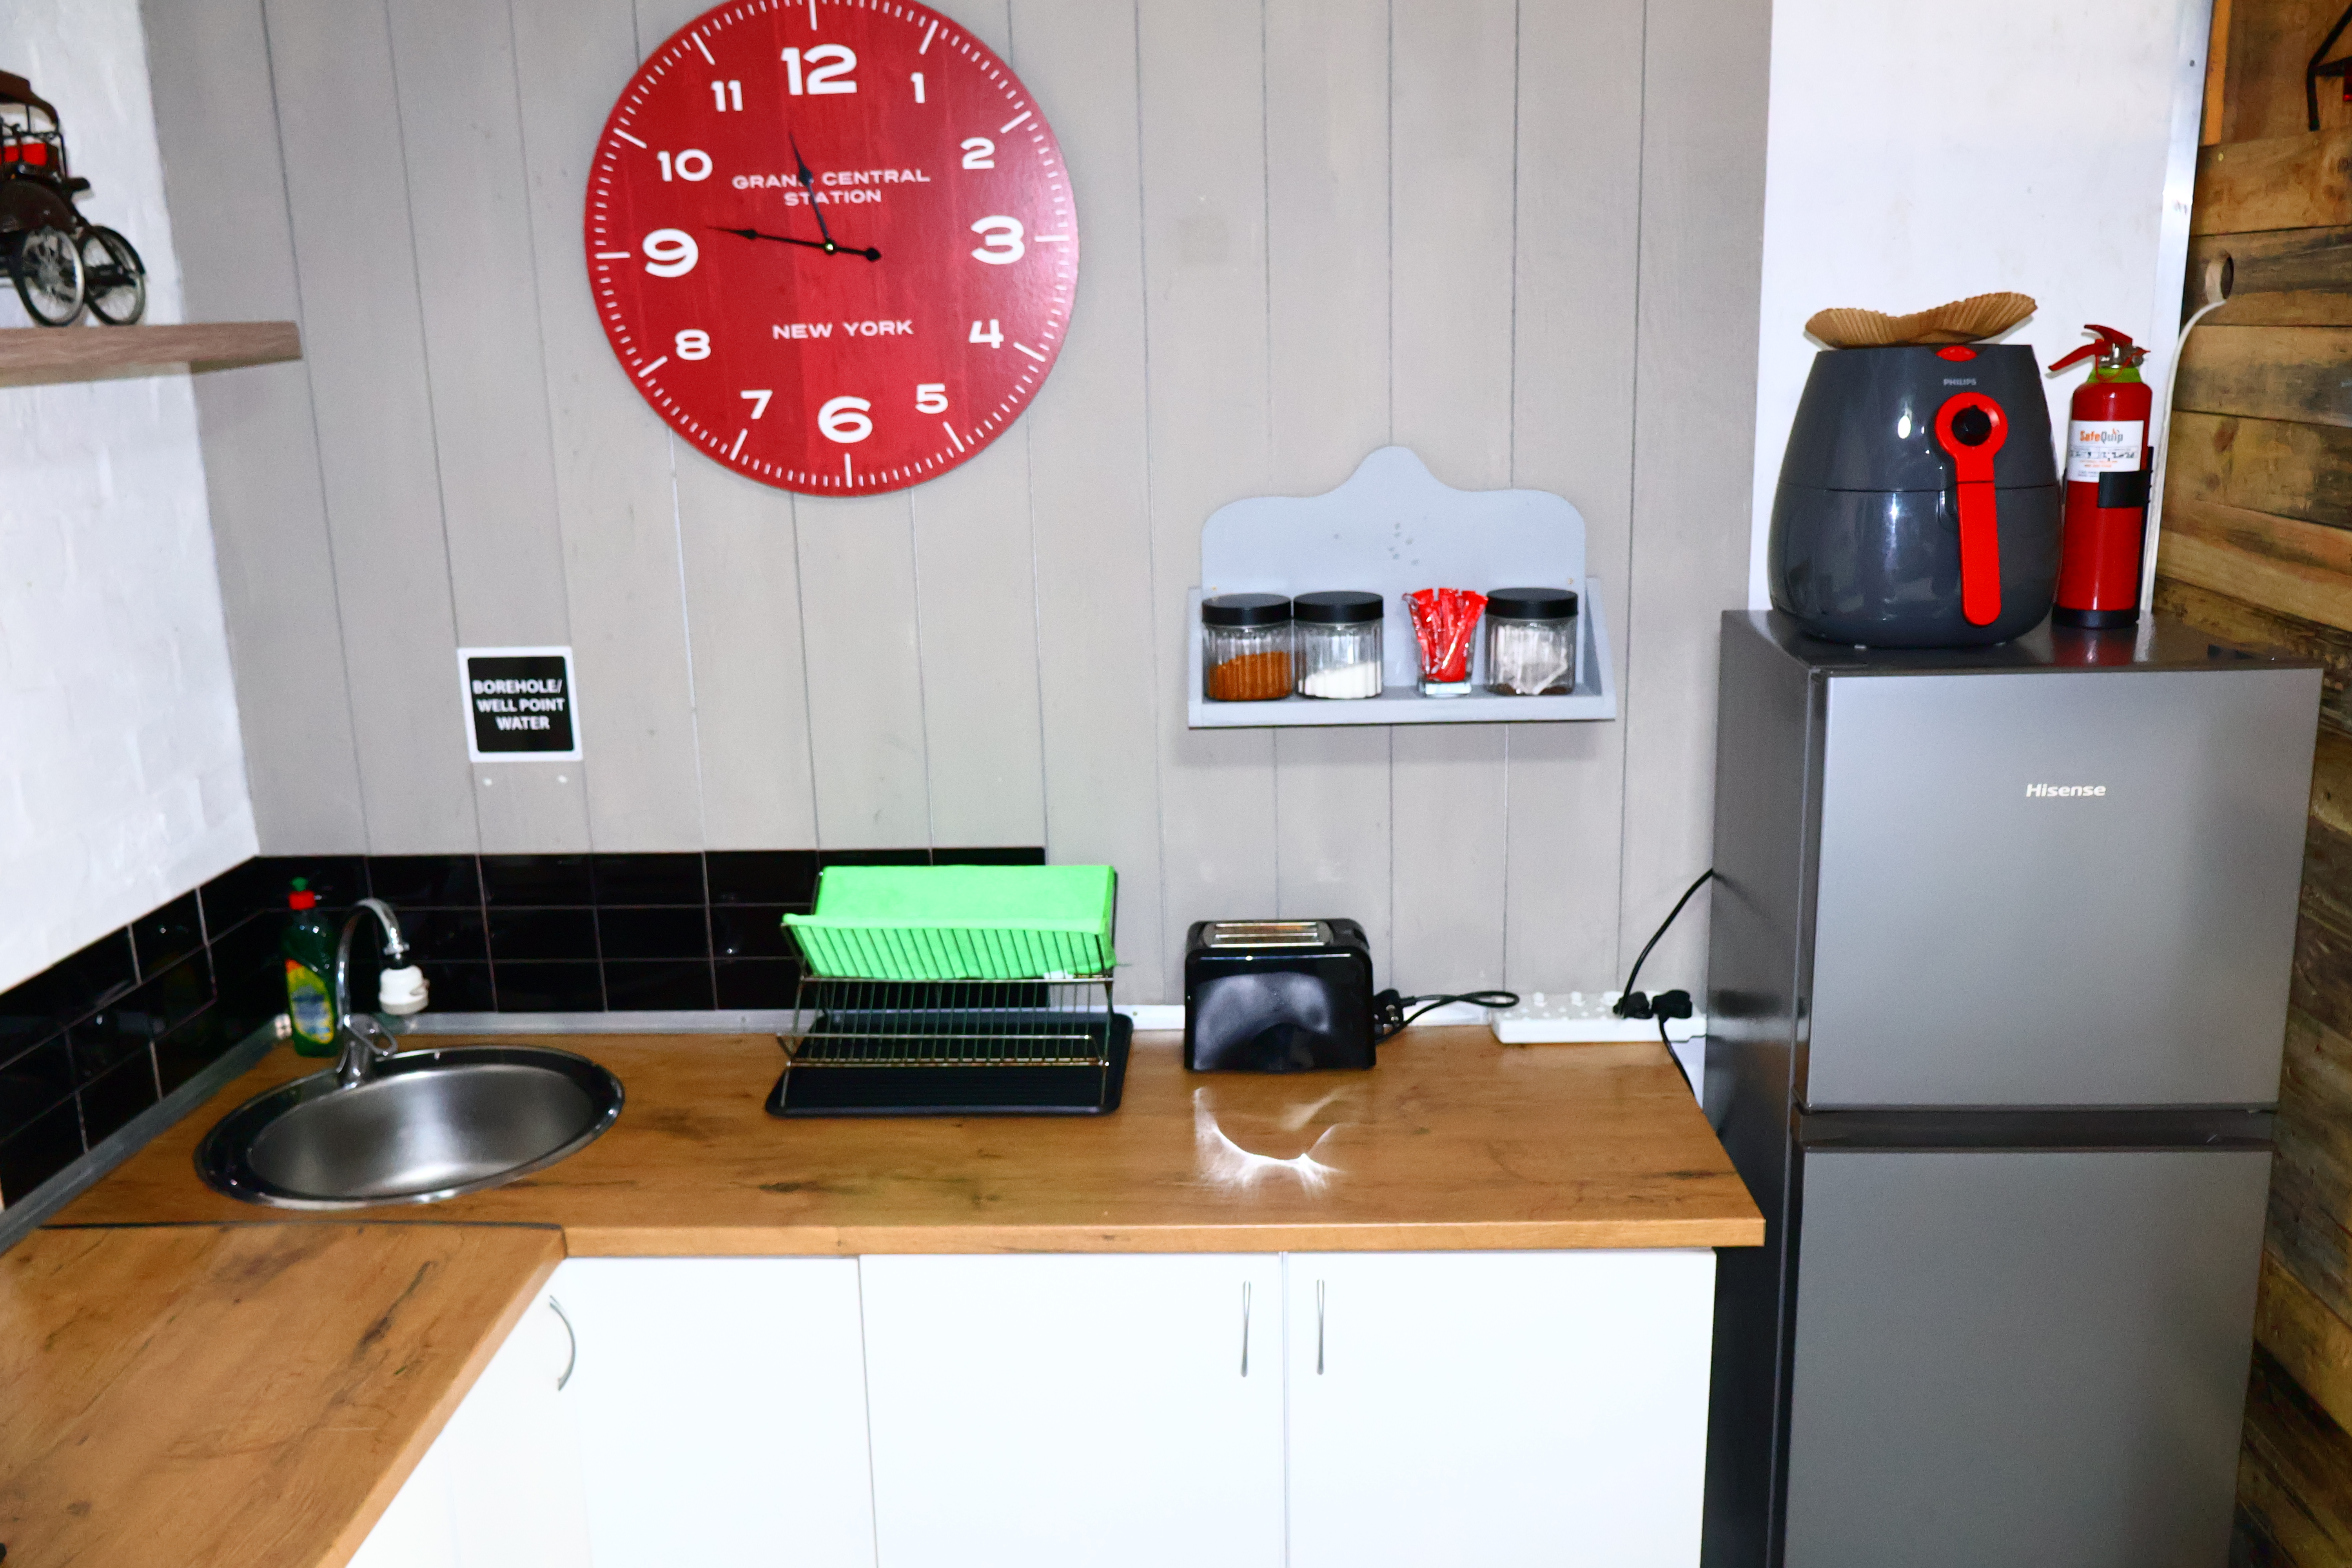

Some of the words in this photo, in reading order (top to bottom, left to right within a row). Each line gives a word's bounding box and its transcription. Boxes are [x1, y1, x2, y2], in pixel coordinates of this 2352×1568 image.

[780, 44, 857, 96] 12
[711, 80, 743, 112] 11
[911, 72, 925, 103] 1
[657, 149, 713, 181] 10
[960, 137, 995, 170] 2
[822, 169, 931, 186] CENTRAL
[784, 189, 882, 206] STATION
[642, 228, 699, 278] 9
[971, 215, 1026, 265] 3
[772, 323, 833, 339] NEW
[843, 319, 914, 337] YORK
[969, 318, 1004, 349] 4
[675, 329, 711, 361] 8
[740, 389, 773, 419] 7
[915, 383, 948, 414] 5
[818, 396, 873, 443] 6
[2080, 428, 2123, 443] SafeQuip
[472, 679, 562, 695] BOREHOLE/
[476, 699, 517, 712] WELL
[519, 697, 565, 712] POINT
[496, 715, 550, 730] WATER
[2026, 784, 2106, 797] Hisense
